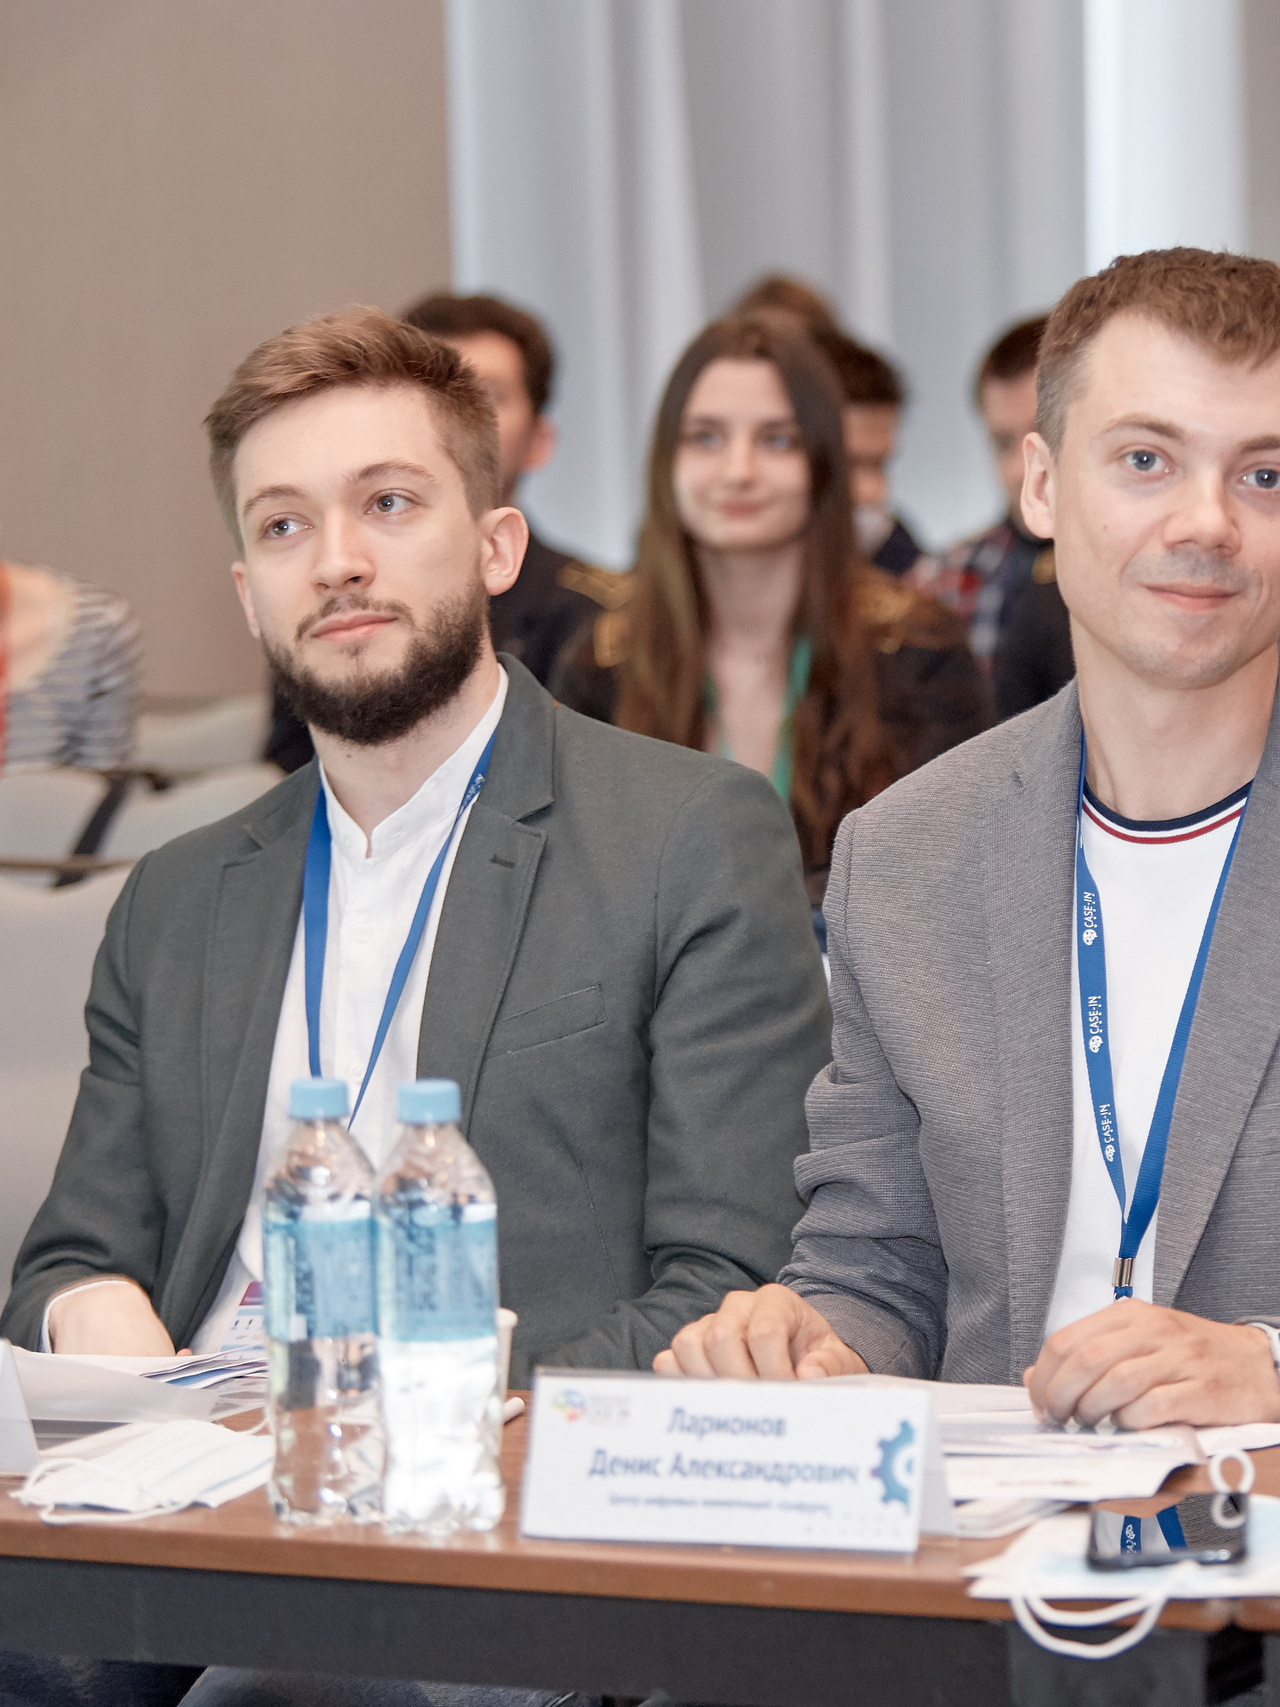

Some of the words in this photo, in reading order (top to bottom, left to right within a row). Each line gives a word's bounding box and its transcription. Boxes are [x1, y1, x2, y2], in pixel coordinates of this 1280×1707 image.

[1083, 891, 1095, 928] CASE-IN
[1088, 995, 1100, 1035] CASE-IN
[1099, 1103, 1113, 1143] CASE-IN
[667, 1407, 787, 1440] Ларионов
[588, 1449, 663, 1479] Денис
[668, 1452, 859, 1485] Александрович
